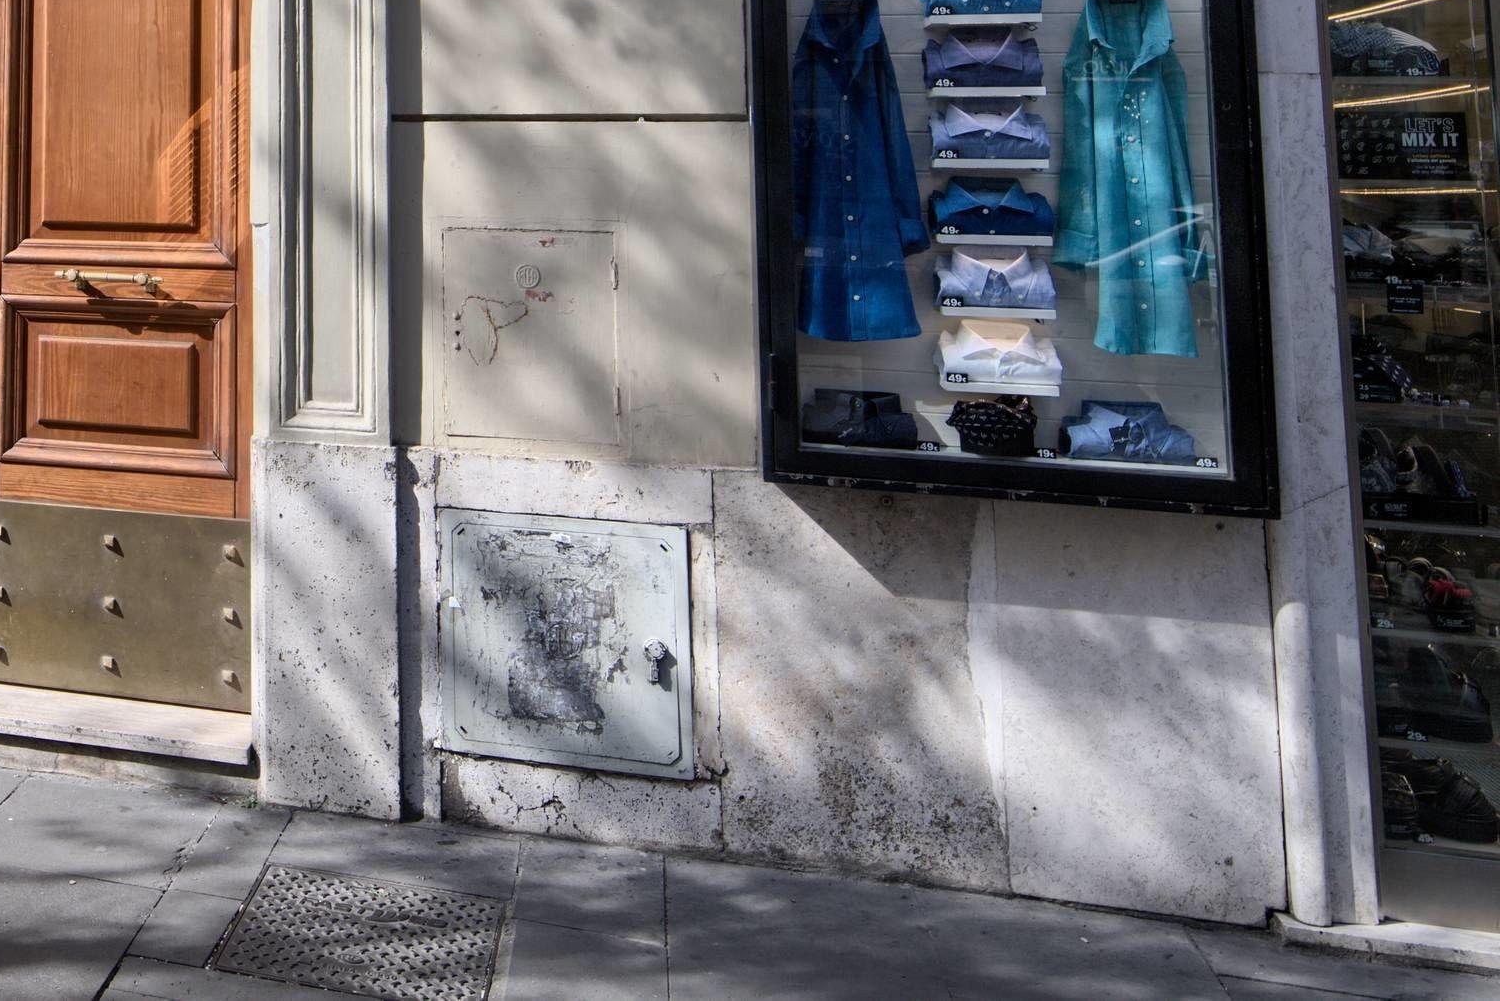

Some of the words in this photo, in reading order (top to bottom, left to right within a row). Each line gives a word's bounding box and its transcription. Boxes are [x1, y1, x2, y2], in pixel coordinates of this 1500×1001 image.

[932, 6, 950, 15] 49€
[935, 79, 954, 87] 49€
[1404, 118, 1454, 133] LET'S
[1401, 133, 1437, 147] MIX
[1442, 133, 1459, 147] IT
[939, 150, 957, 158] 49€
[941, 226, 960, 234] 49€
[943, 298, 962, 307] 49€
[948, 374, 967, 383] 49€
[920, 442, 938, 451] 49€
[1037, 449, 1055, 458] 19€
[1196, 458, 1217, 468] 49€
